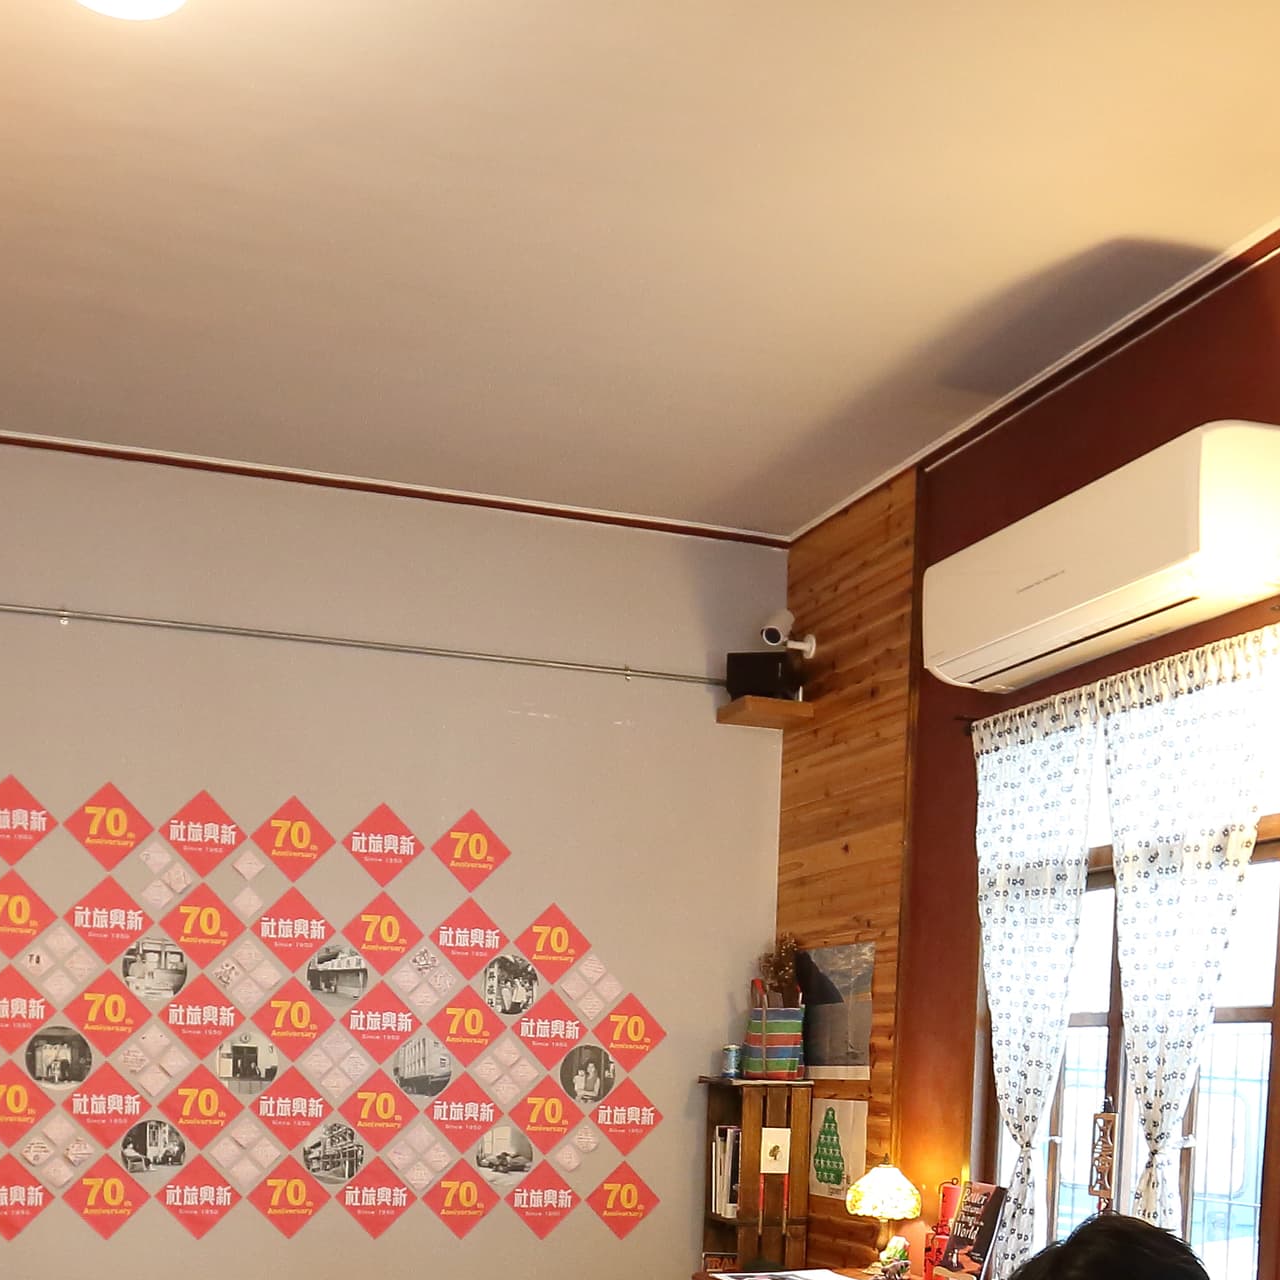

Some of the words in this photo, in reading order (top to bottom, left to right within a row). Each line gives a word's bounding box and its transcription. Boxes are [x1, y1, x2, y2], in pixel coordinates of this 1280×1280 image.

[85, 837, 134, 847] Anniversary
[272, 849, 317, 859] Anniversary
[450, 860, 492, 870] Anniversary
[180, 936, 227, 946] Anniversary
[361, 944, 405, 953] Anniversary
[532, 954, 574, 963] Anniversary
[84, 1024, 131, 1033] Anniversary
[271, 1030, 316, 1038] Anniversary
[446, 1036, 488, 1045] Anniversary
[609, 1042, 649, 1051] Anniversary
[178, 1118, 224, 1126] Anniversary
[526, 1125, 567, 1133] Anniversary
